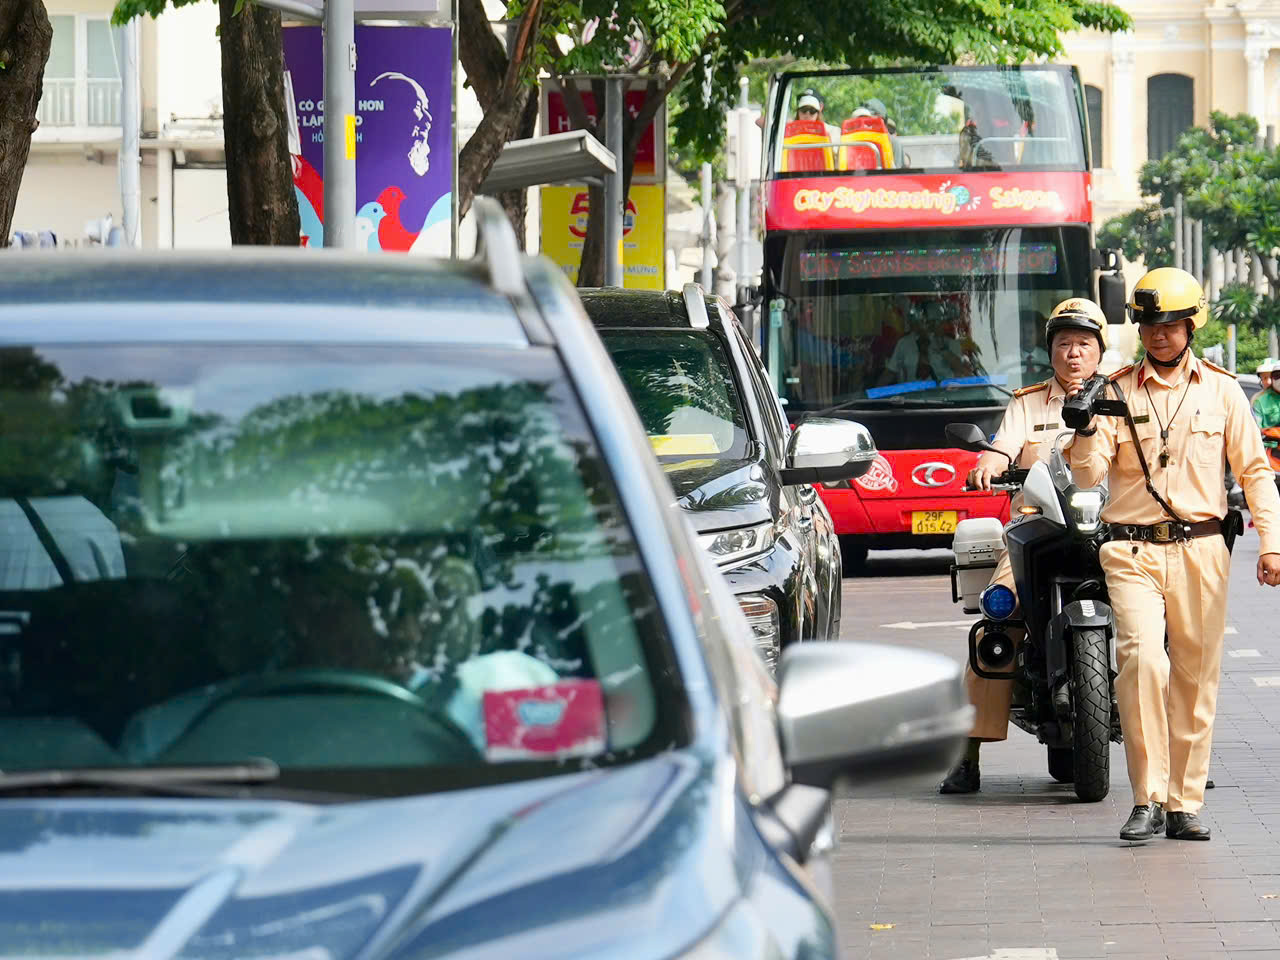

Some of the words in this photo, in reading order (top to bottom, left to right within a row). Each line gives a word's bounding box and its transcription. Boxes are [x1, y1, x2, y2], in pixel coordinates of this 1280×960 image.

[358, 99, 384, 112] HƠN
[800, 255, 840, 278] City
[925, 512, 945, 522] 29F
